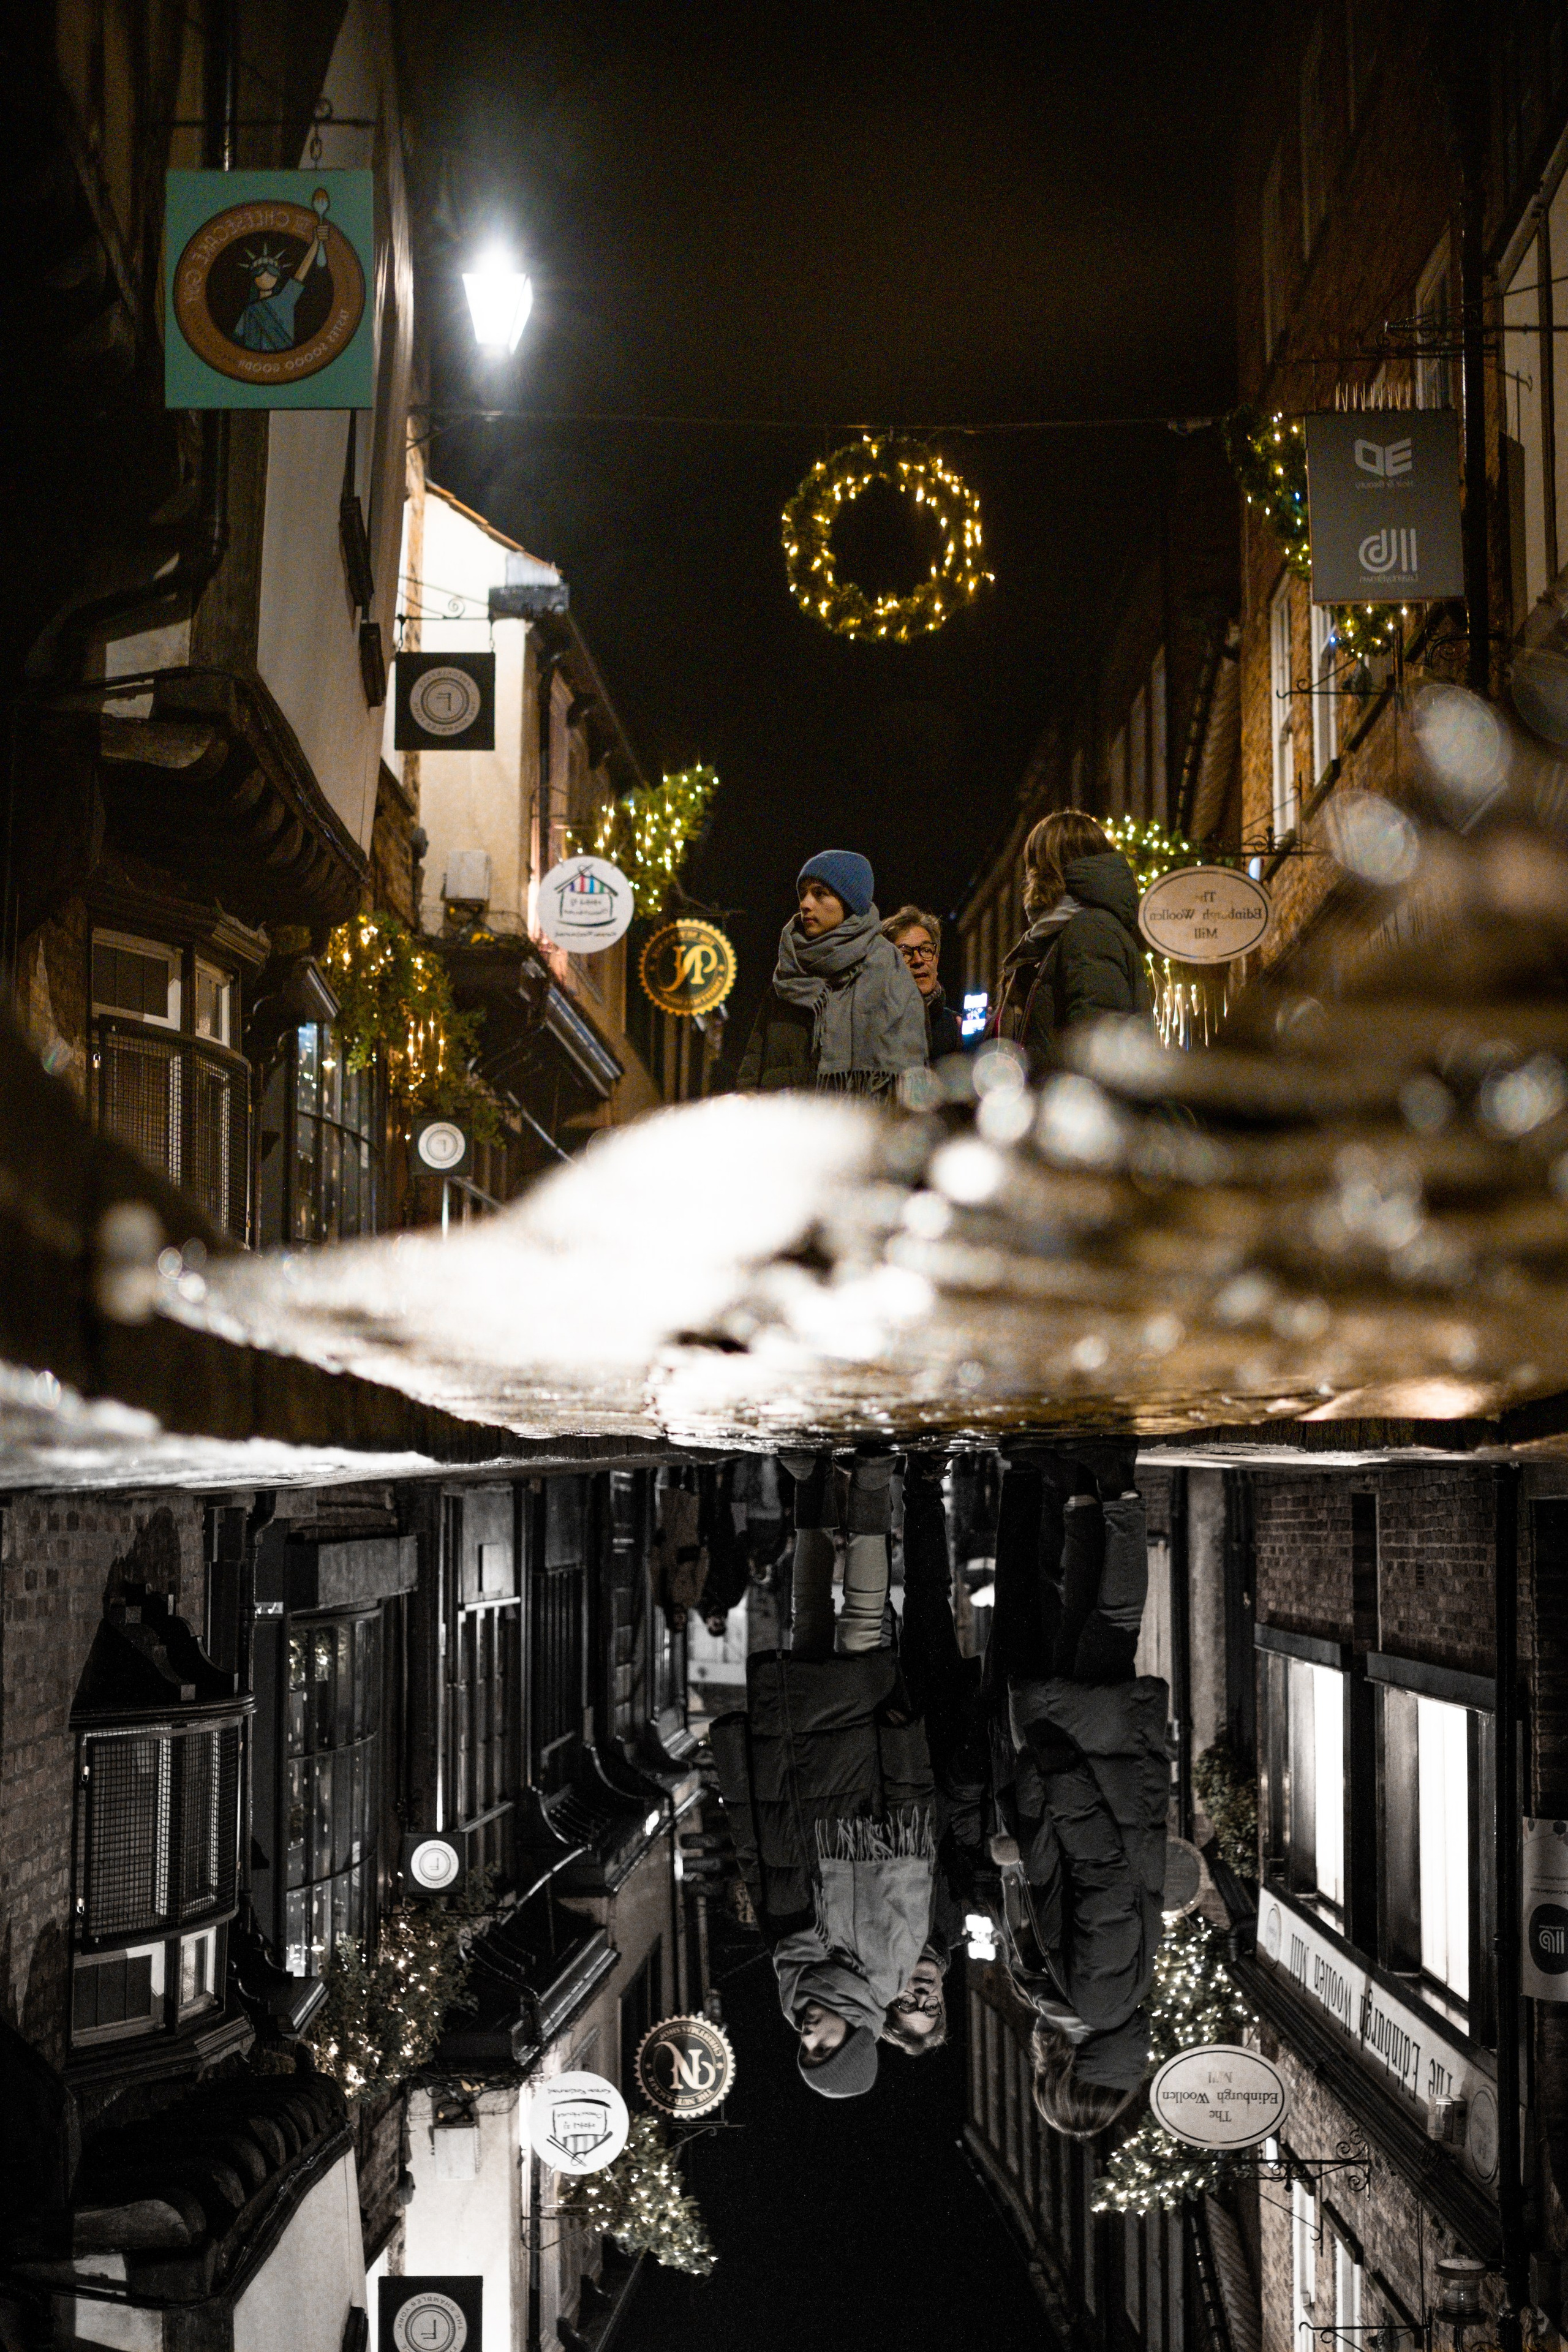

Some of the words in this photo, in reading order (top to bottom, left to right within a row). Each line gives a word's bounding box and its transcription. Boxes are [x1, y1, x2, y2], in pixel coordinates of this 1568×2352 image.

[1289, 1933, 1309, 1997] Mill
[1314, 1954, 1352, 2040] Woollen
[656, 2026, 681, 2041] SHOP
[682, 2025, 723, 2058] CHRISTMAS
[1357, 1988, 1421, 2105] Edinburgh
[654, 2041, 716, 2090] N
[645, 2076, 696, 2106] NUTCRACKER
[695, 2087, 715, 2104] THE
[1162, 2092, 1210, 2103] Woollen
[1216, 2089, 1278, 2104] Edinburgh
[1209, 2111, 1232, 2122] The
[410, 2296, 456, 2313] SHAMBLES
[397, 2306, 411, 2329] YORK
[454, 2312, 464, 2331] THE
[420, 2319, 436, 2340] F
